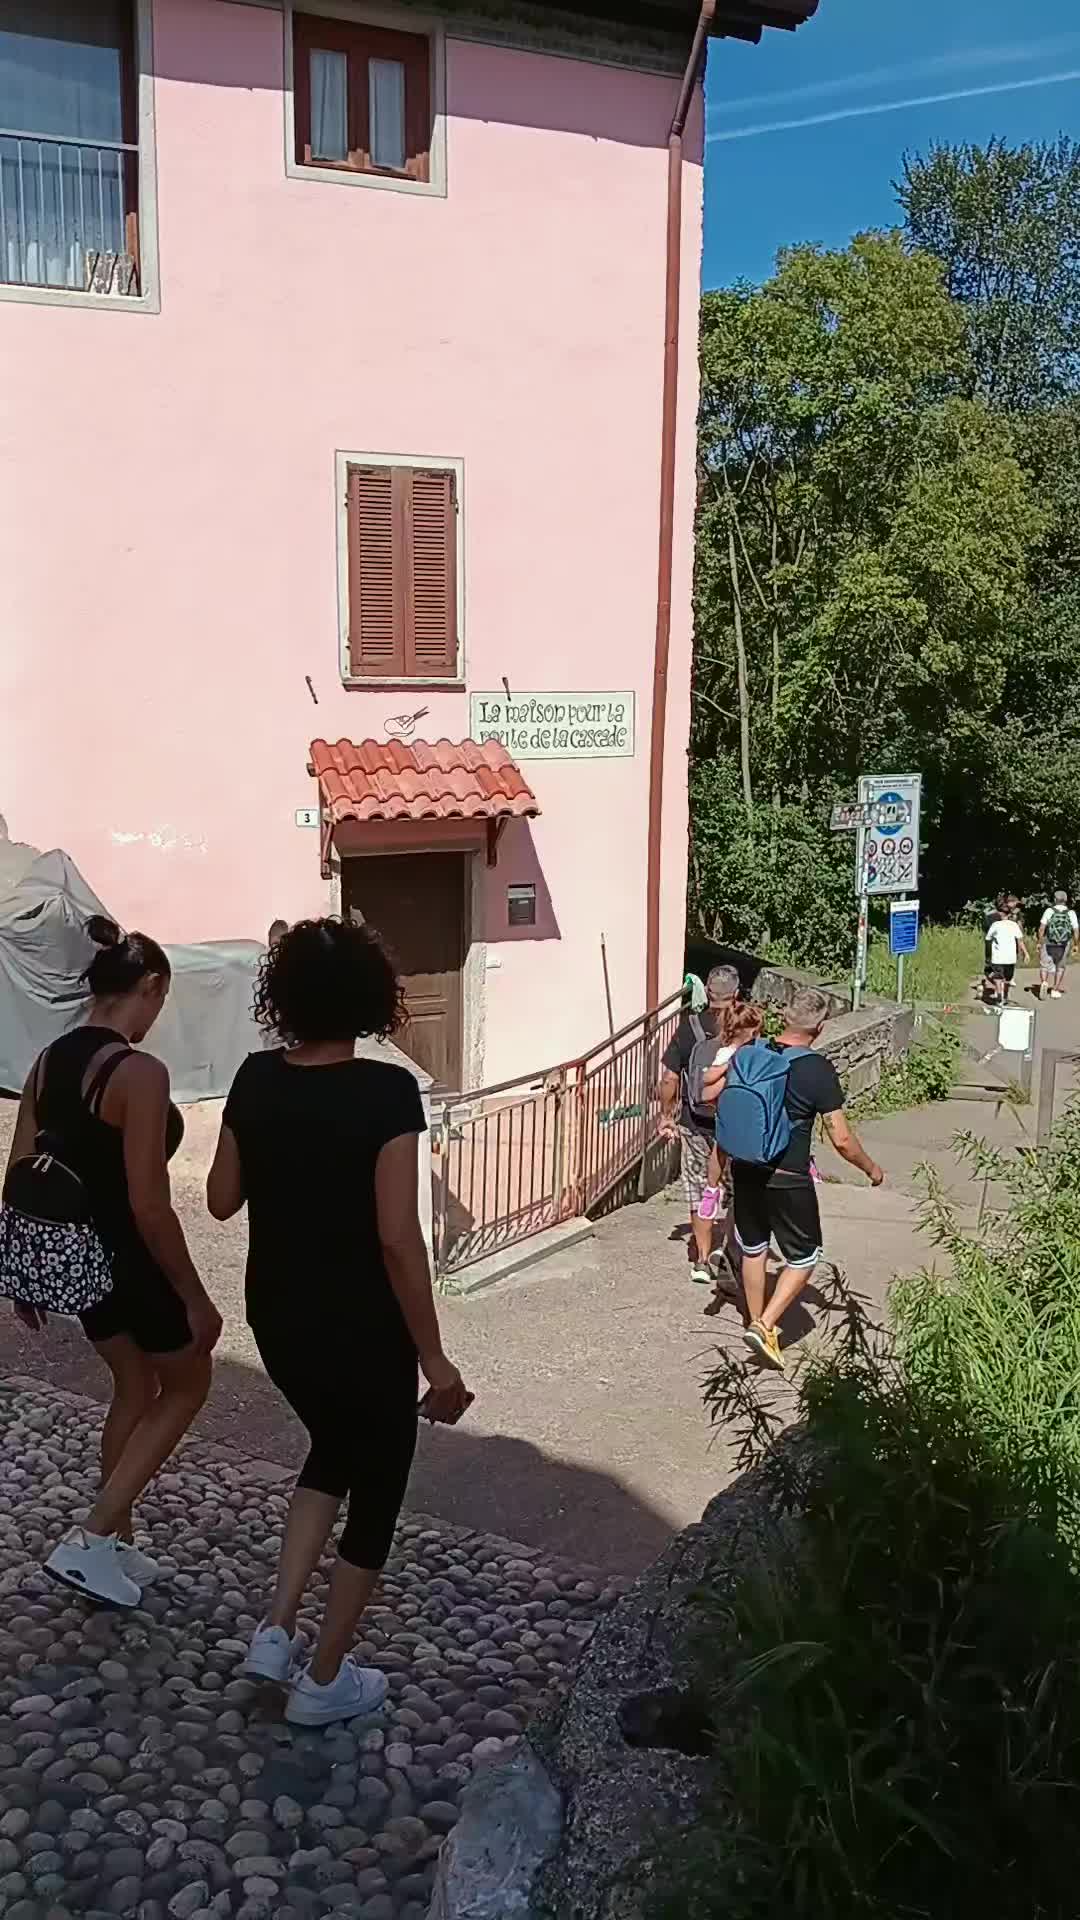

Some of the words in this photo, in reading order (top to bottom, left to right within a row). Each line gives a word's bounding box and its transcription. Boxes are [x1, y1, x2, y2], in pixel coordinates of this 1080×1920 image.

[479, 702, 501, 723] La
[505, 699, 566, 723] maison
[569, 703, 606, 725] pour
[608, 702, 625, 722] la
[530, 728, 551, 748] de
[552, 728, 569, 747] la
[304, 813, 311, 823] 3
